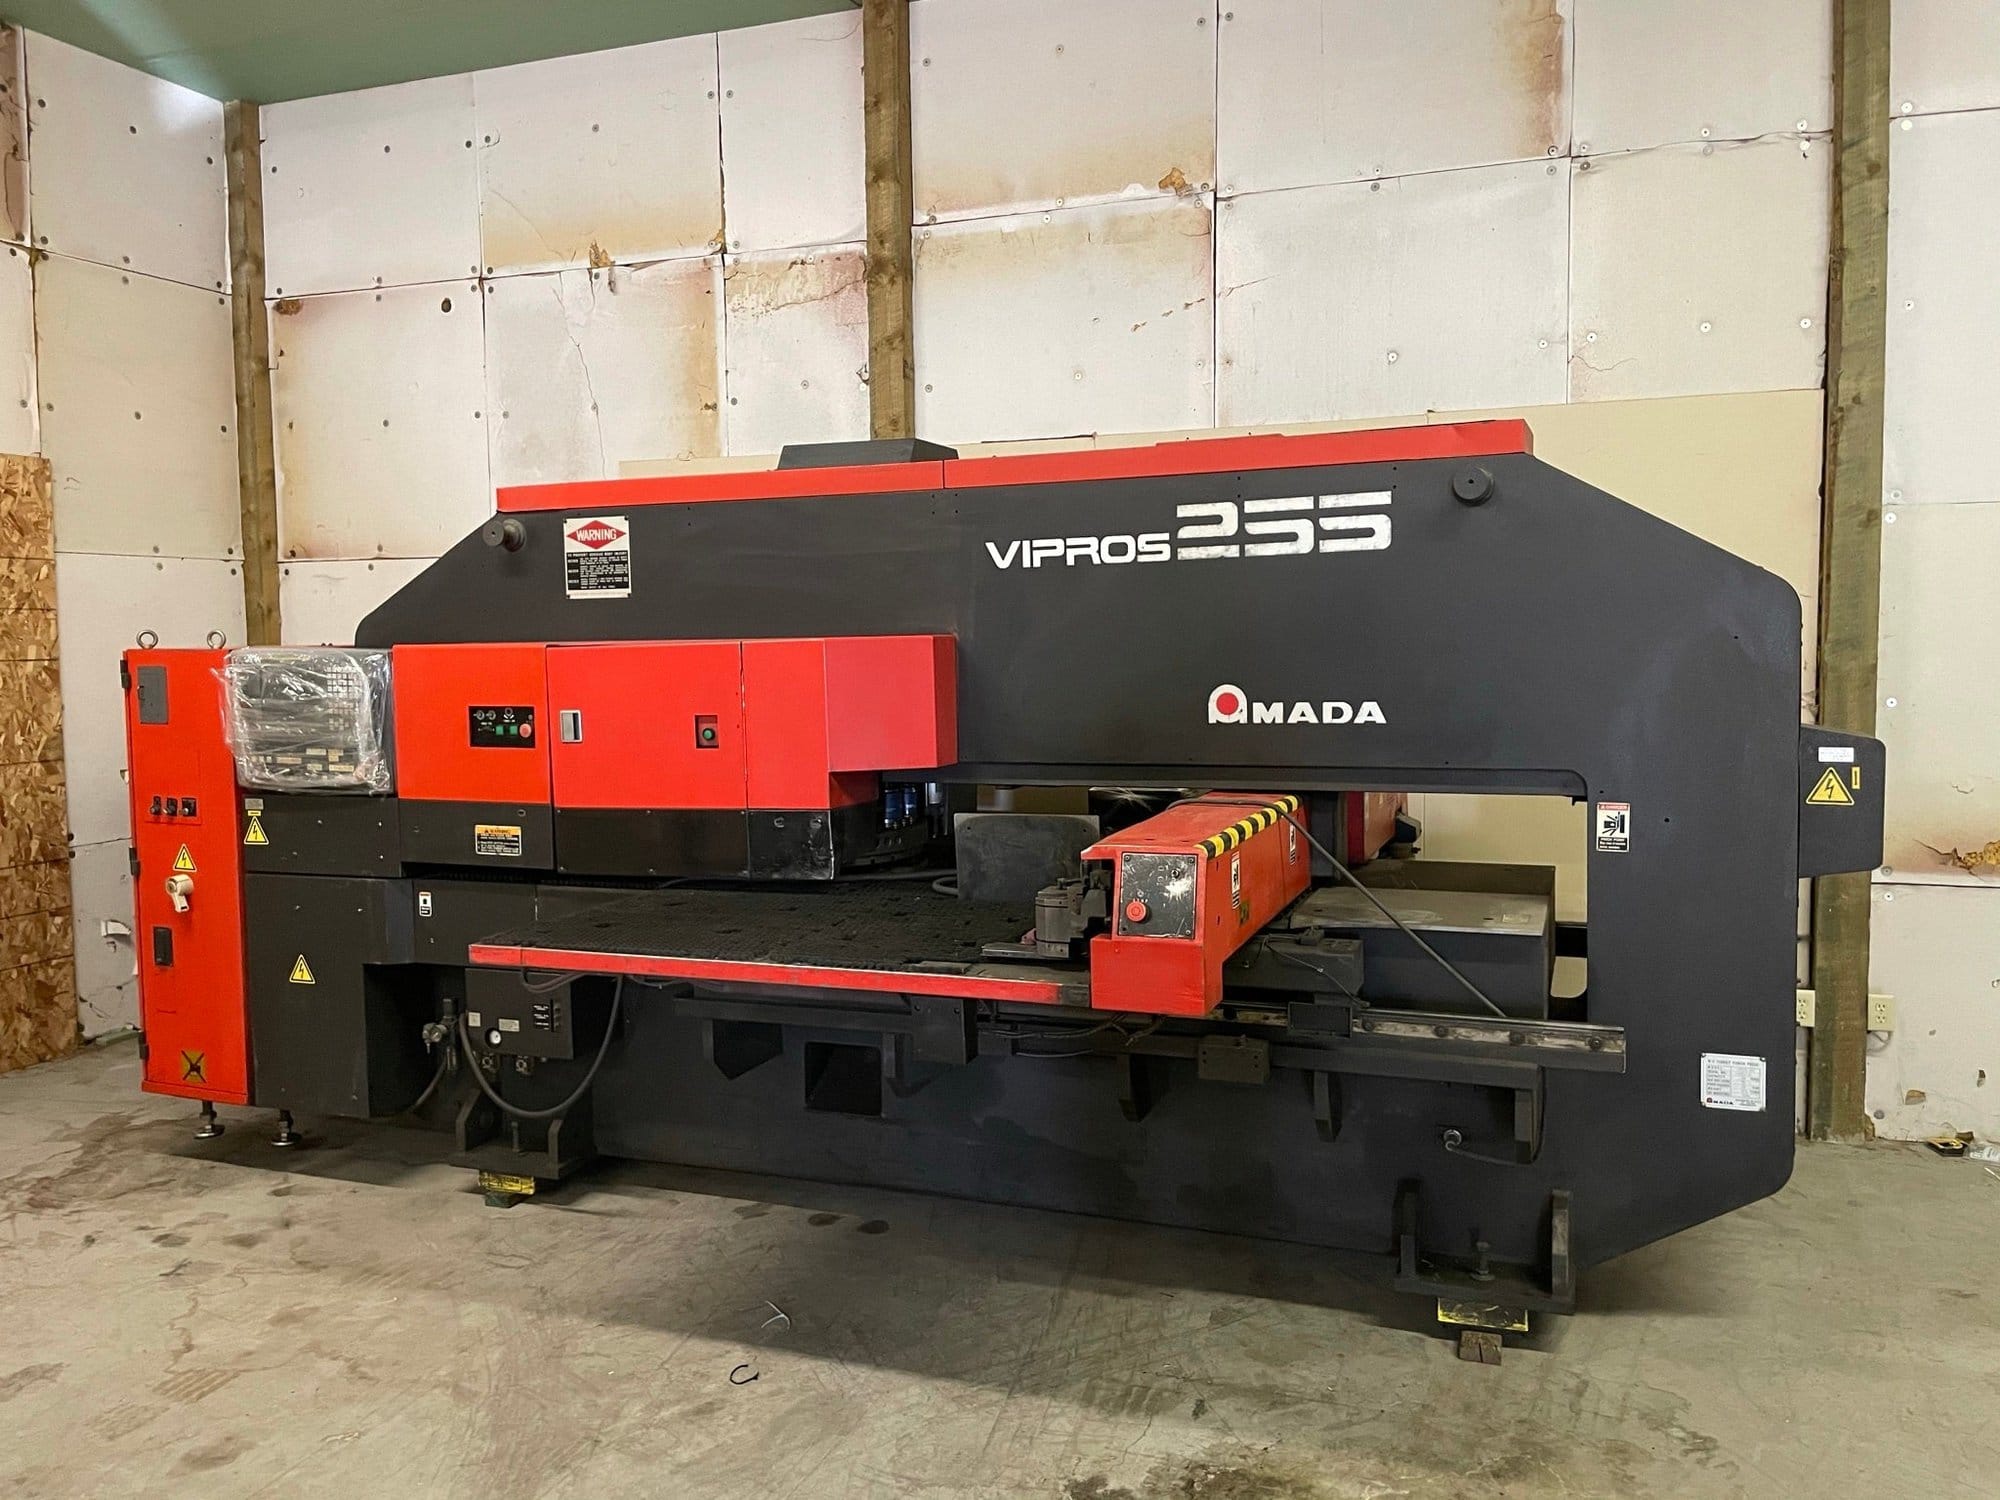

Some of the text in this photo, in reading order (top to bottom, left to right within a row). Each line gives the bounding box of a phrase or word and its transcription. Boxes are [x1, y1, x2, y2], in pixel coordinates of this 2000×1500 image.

[576, 529, 617, 541] WARNING
[984, 490, 1392, 569] VIPROS 255
[1208, 684, 1388, 725] AMADA
